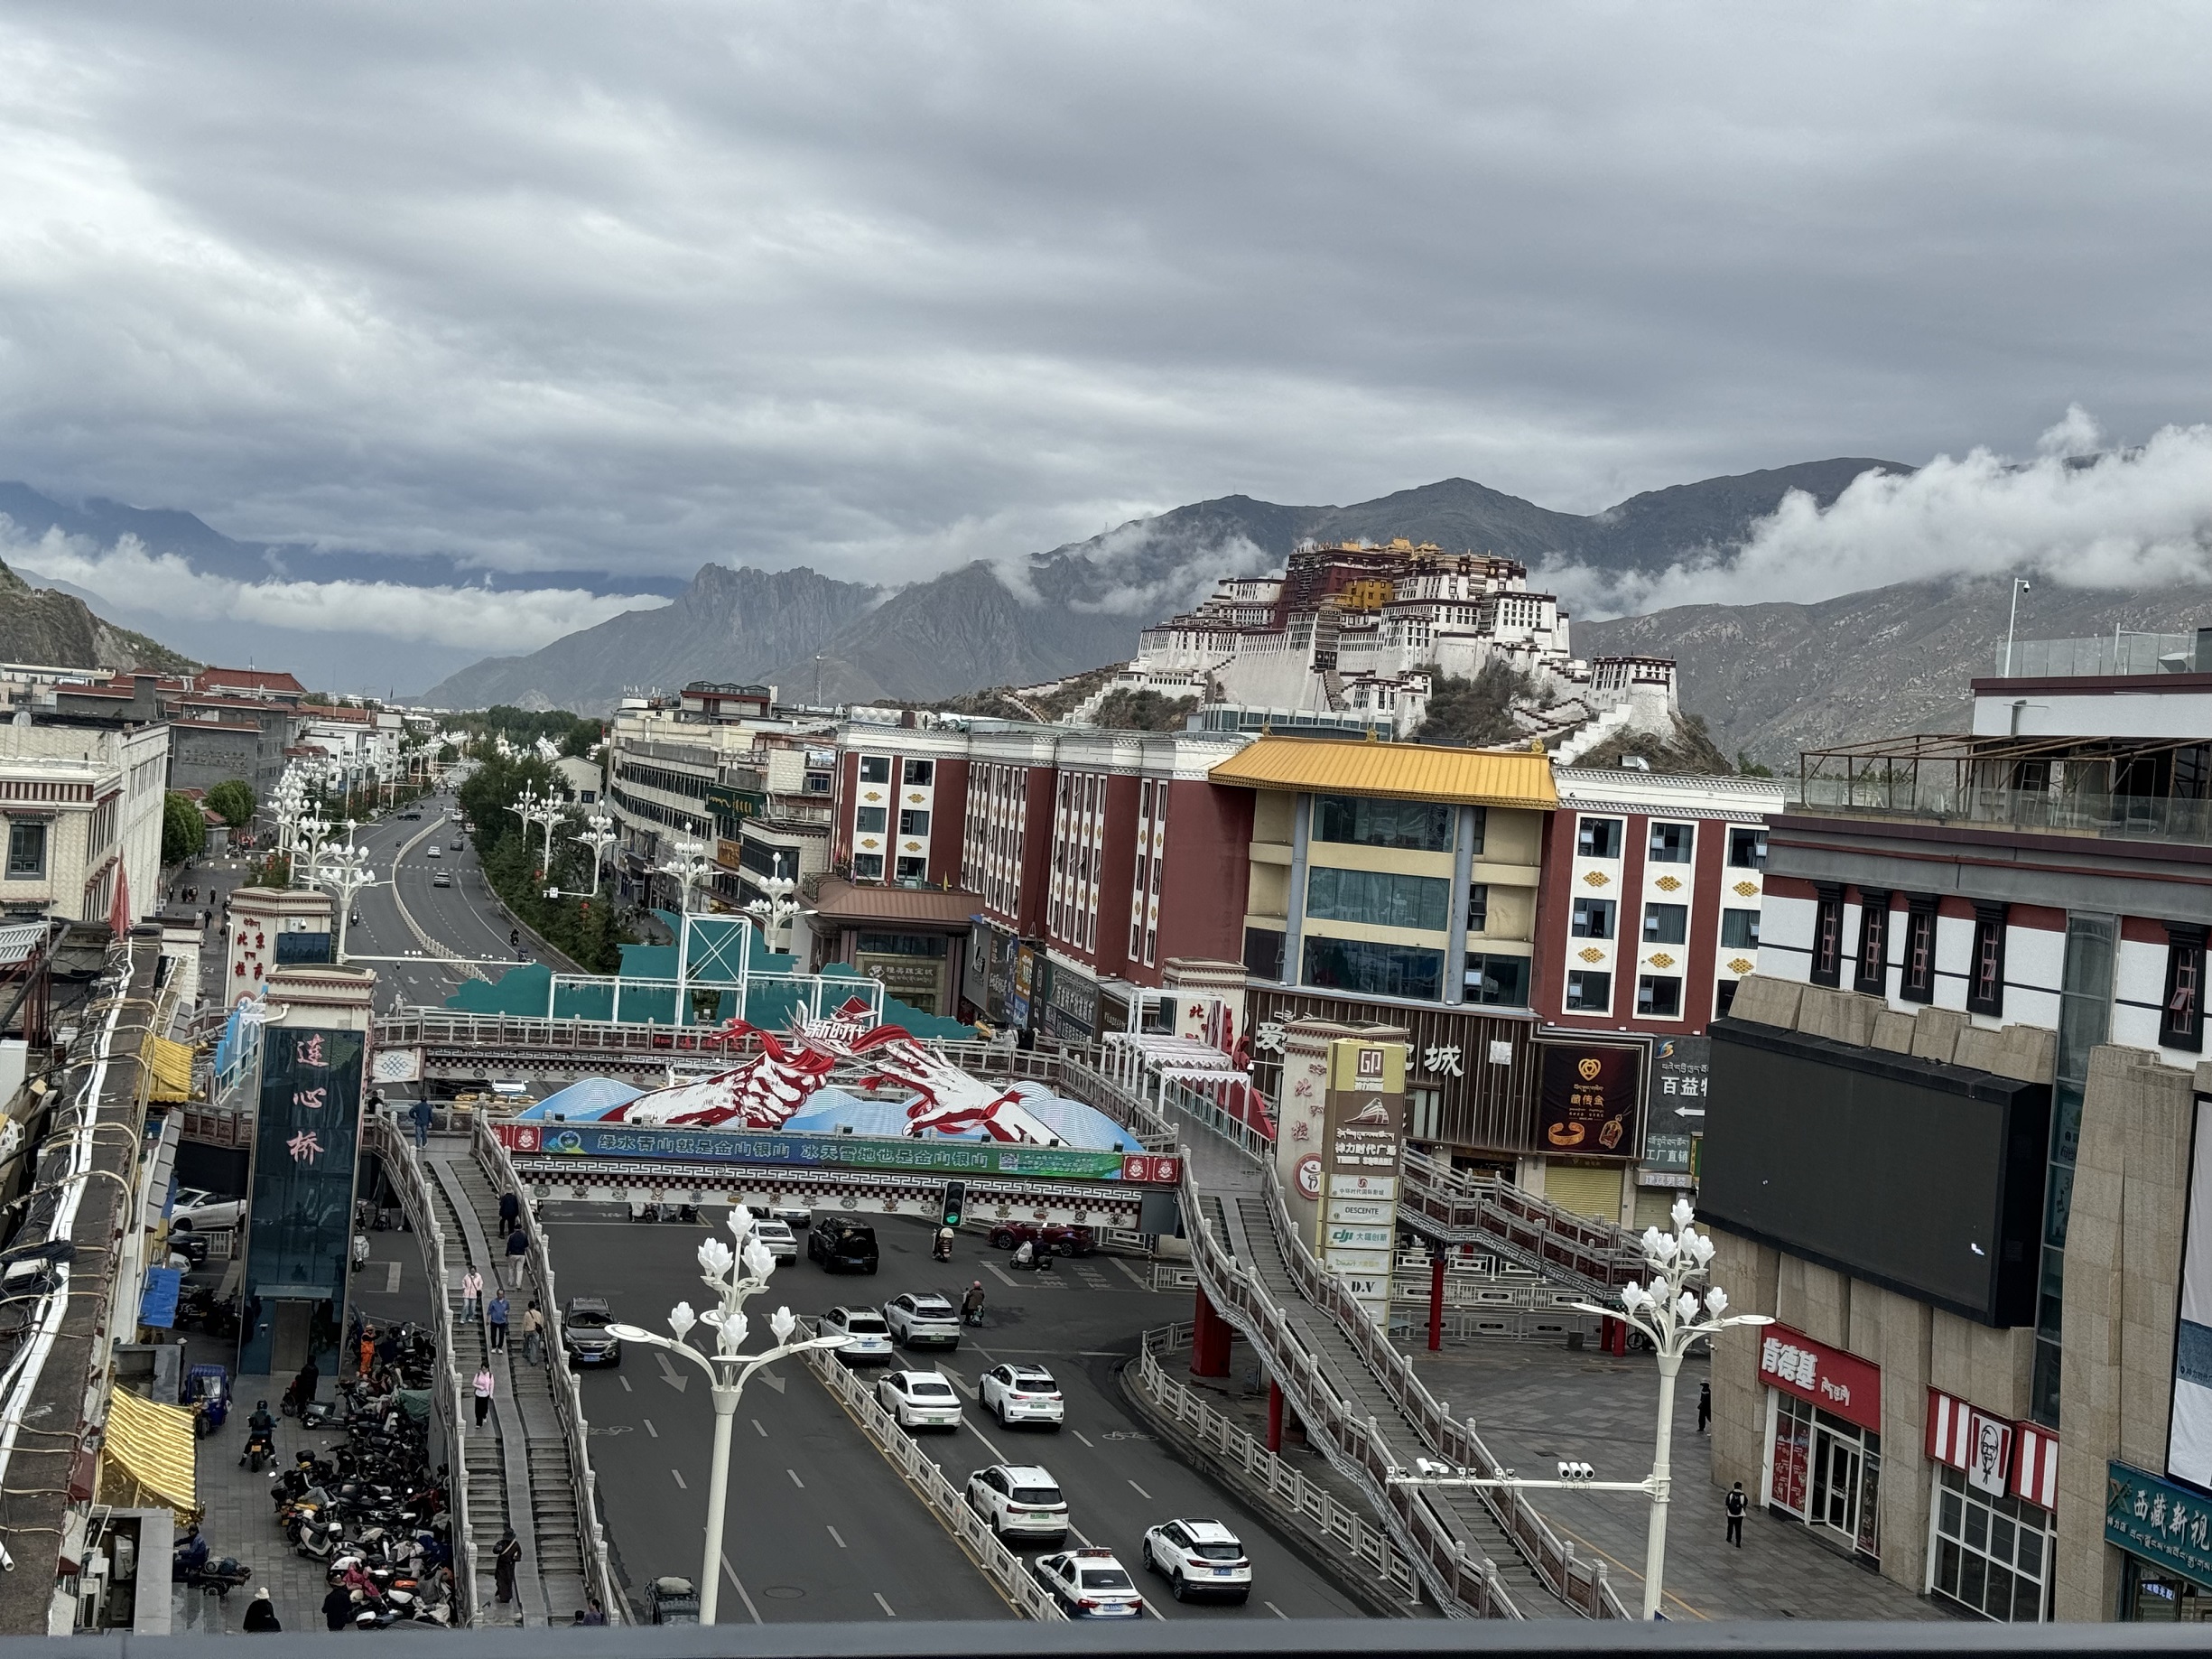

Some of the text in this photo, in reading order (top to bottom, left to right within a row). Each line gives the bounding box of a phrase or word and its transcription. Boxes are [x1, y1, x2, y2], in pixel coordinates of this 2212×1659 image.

[237, 931, 265, 950] 北京
[1189, 1003, 1204, 1018] 北
[804, 1019, 865, 1044] 新时代
[597, 1133, 989, 1168] 绿水青山就是金山银山 冰天雪地也是金山银山
[1335, 1142, 1397, 1156] 神力时代广场
[1646, 1149, 1689, 1164] 工厂直销
[1362, 1157, 1394, 1167] SQUARE
[1345, 1207, 1380, 1216] DESCENTE
[1356, 1233, 1388, 1242] 大疆创新
[1762, 1337, 1817, 1390] 肯德基
[2133, 1489, 2211, 1552] 西藏新视
